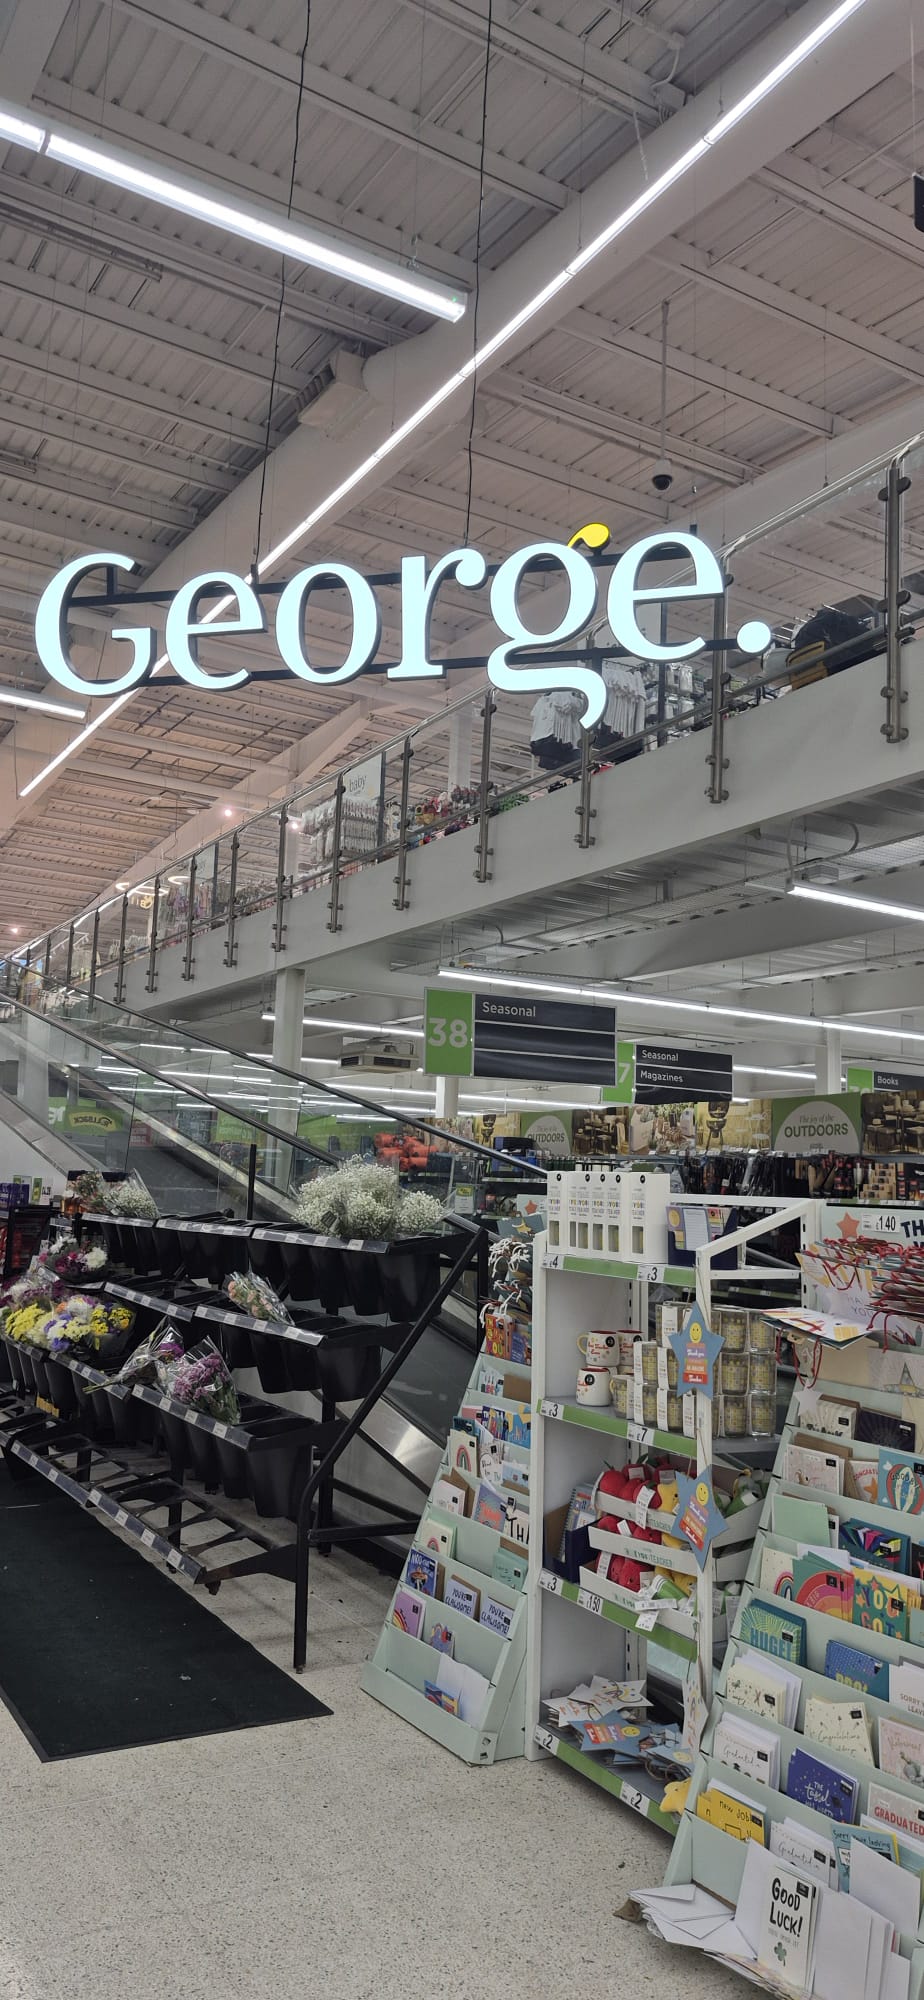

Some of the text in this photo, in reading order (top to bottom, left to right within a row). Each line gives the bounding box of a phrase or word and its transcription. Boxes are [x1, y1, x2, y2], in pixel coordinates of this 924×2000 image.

[34, 523, 772, 731] George.
[482, 1002, 536, 1018] Seasonal
[428, 1018, 468, 1048] 38
[642, 1050, 679, 1062] Seasonal
[640, 1071, 683, 1083] Magazines
[877, 1075, 899, 1086] Books
[785, 1123, 848, 1138] OUTDOORS
[549, 1256, 559, 1268] £4
[647, 1267, 658, 1281] £3
[549, 1404, 559, 1417] £3
[637, 1428, 648, 1442] £7
[505, 1514, 529, 1545] TH
[547, 1577, 557, 1591] £3
[861, 1587, 901, 1618] YOU
[543, 1734, 553, 1749] £2
[631, 1792, 642, 1810] £2
[874, 1806, 924, 1836] GRADUATED
[772, 1877, 801, 1911] GOOD
[770, 1901, 804, 1938] LUCK!
